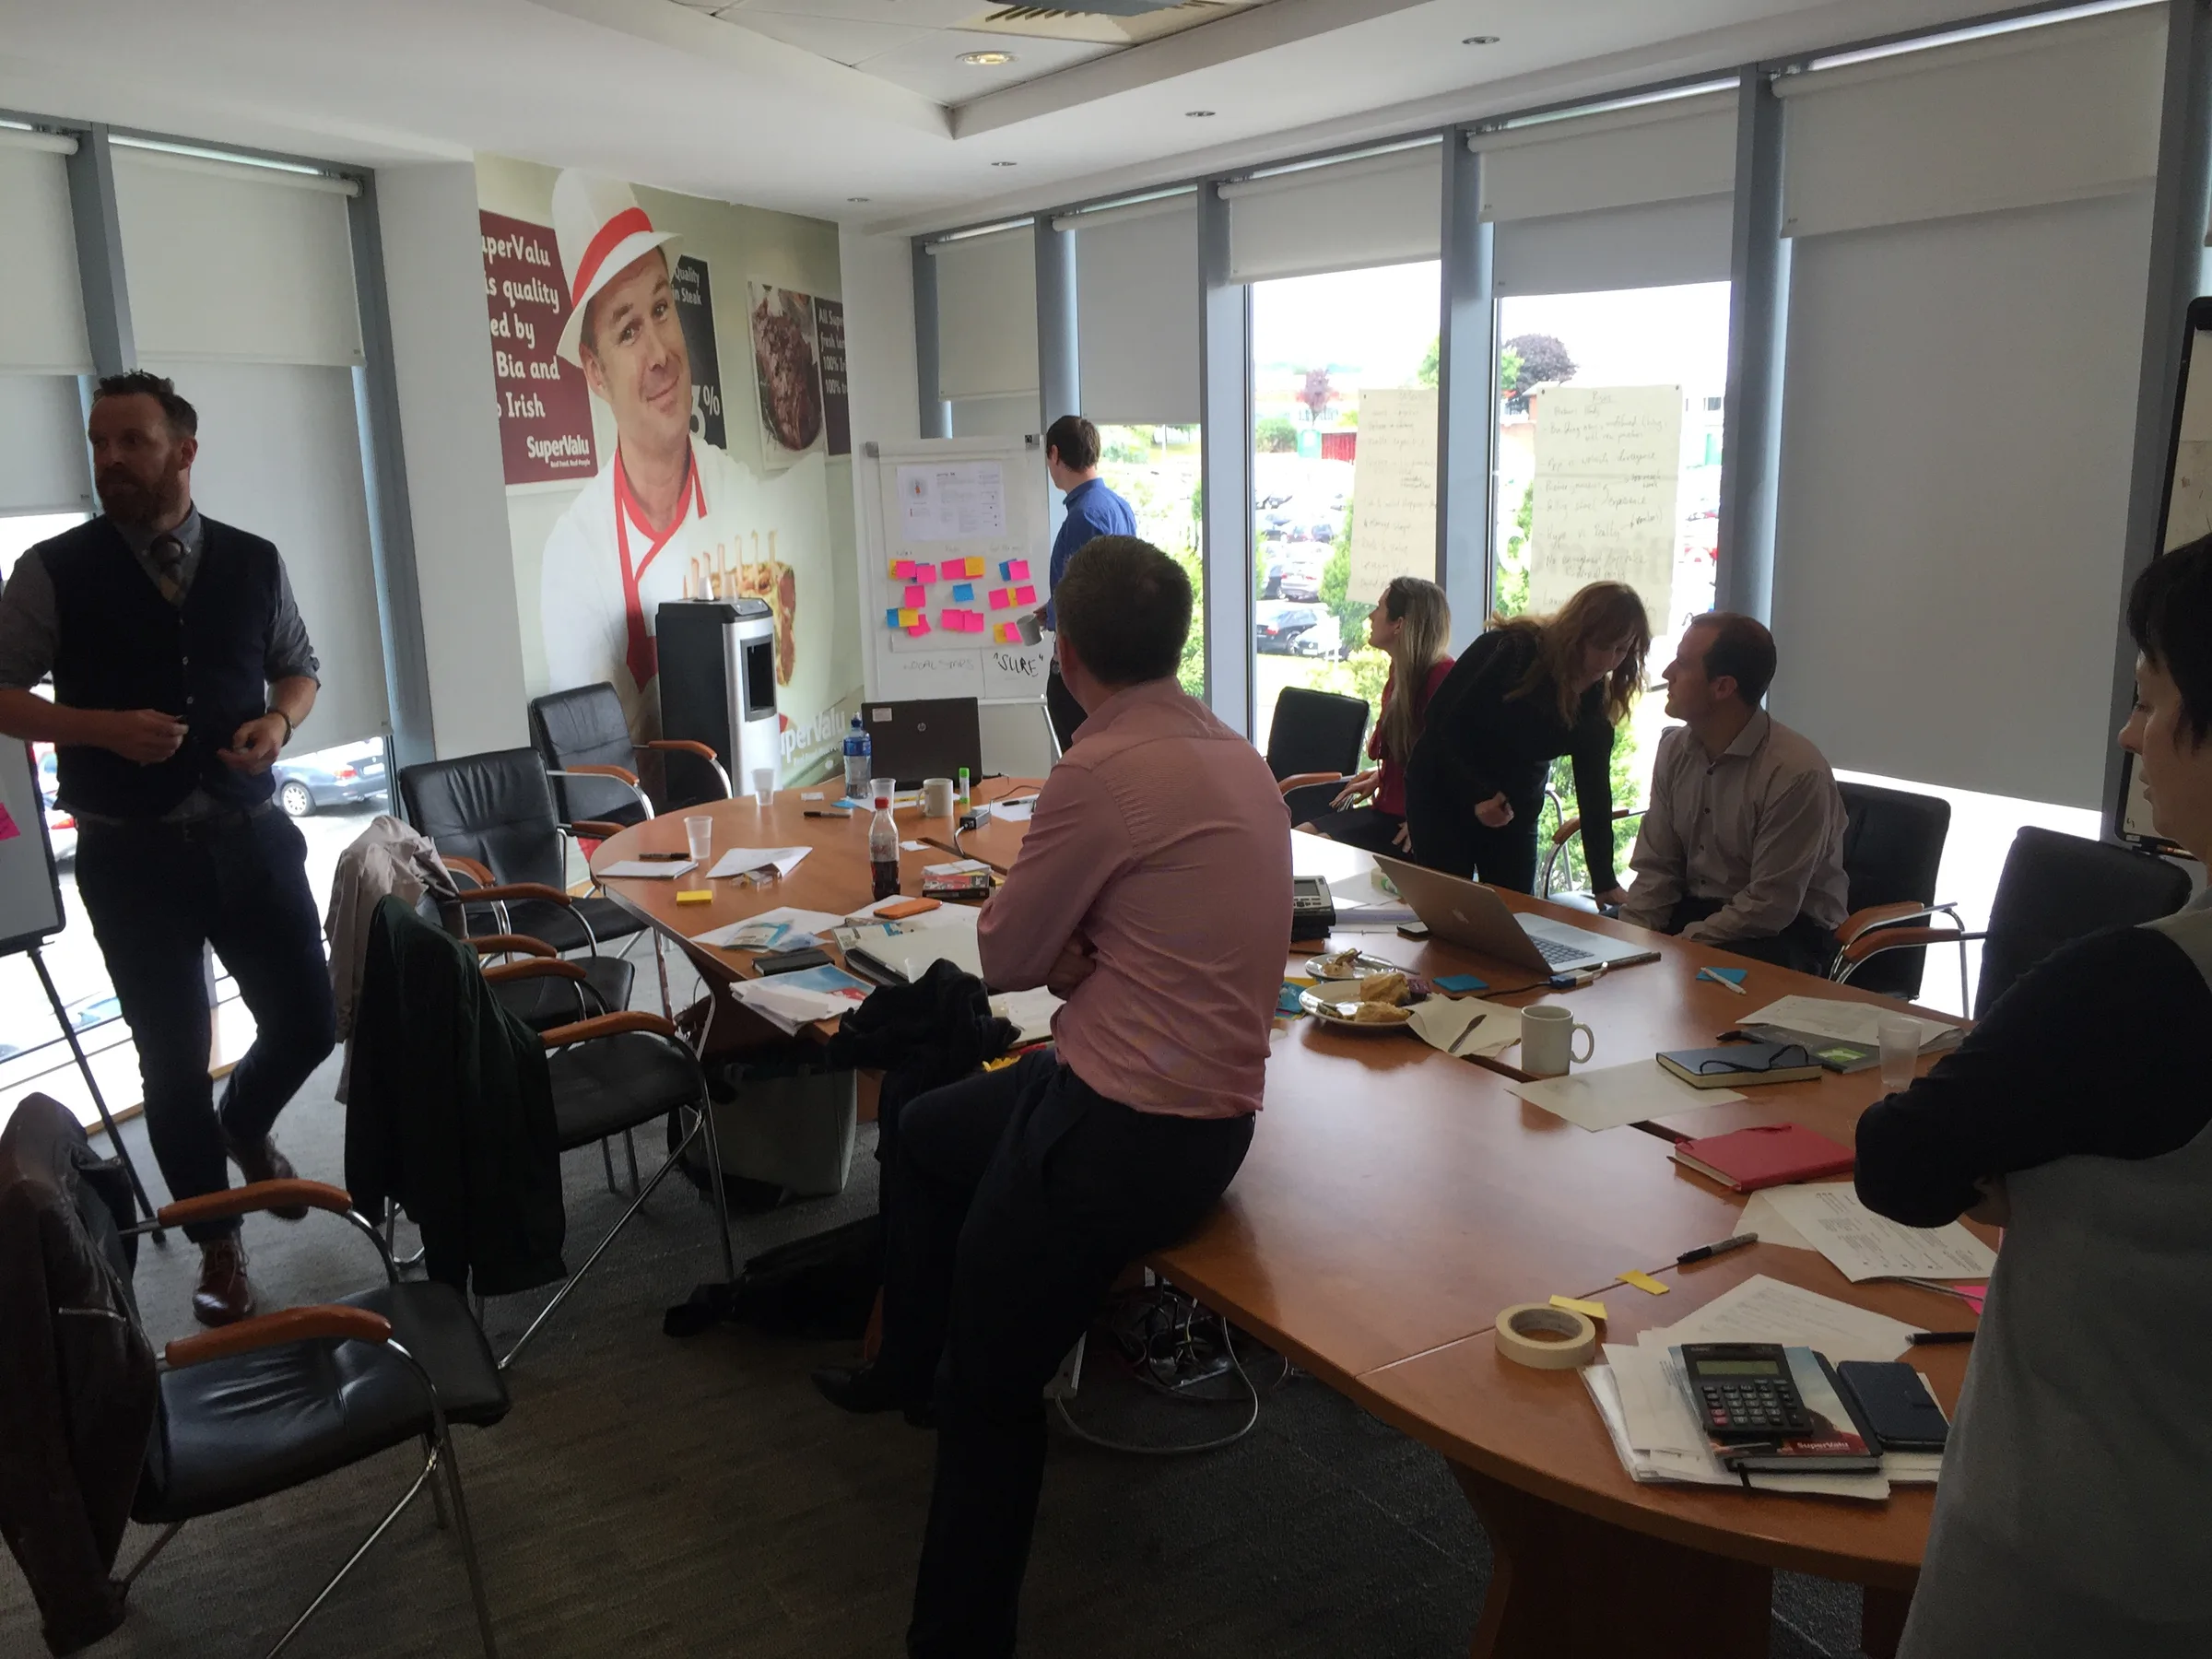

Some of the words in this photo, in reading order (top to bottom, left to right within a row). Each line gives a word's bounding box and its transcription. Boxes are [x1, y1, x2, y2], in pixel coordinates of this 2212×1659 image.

[502, 276, 559, 313] quality
[513, 312, 535, 349] by
[496, 350, 526, 379] Bia
[530, 355, 560, 380] and
[505, 392, 546, 418] Irish
[526, 434, 590, 464] SuperValu
